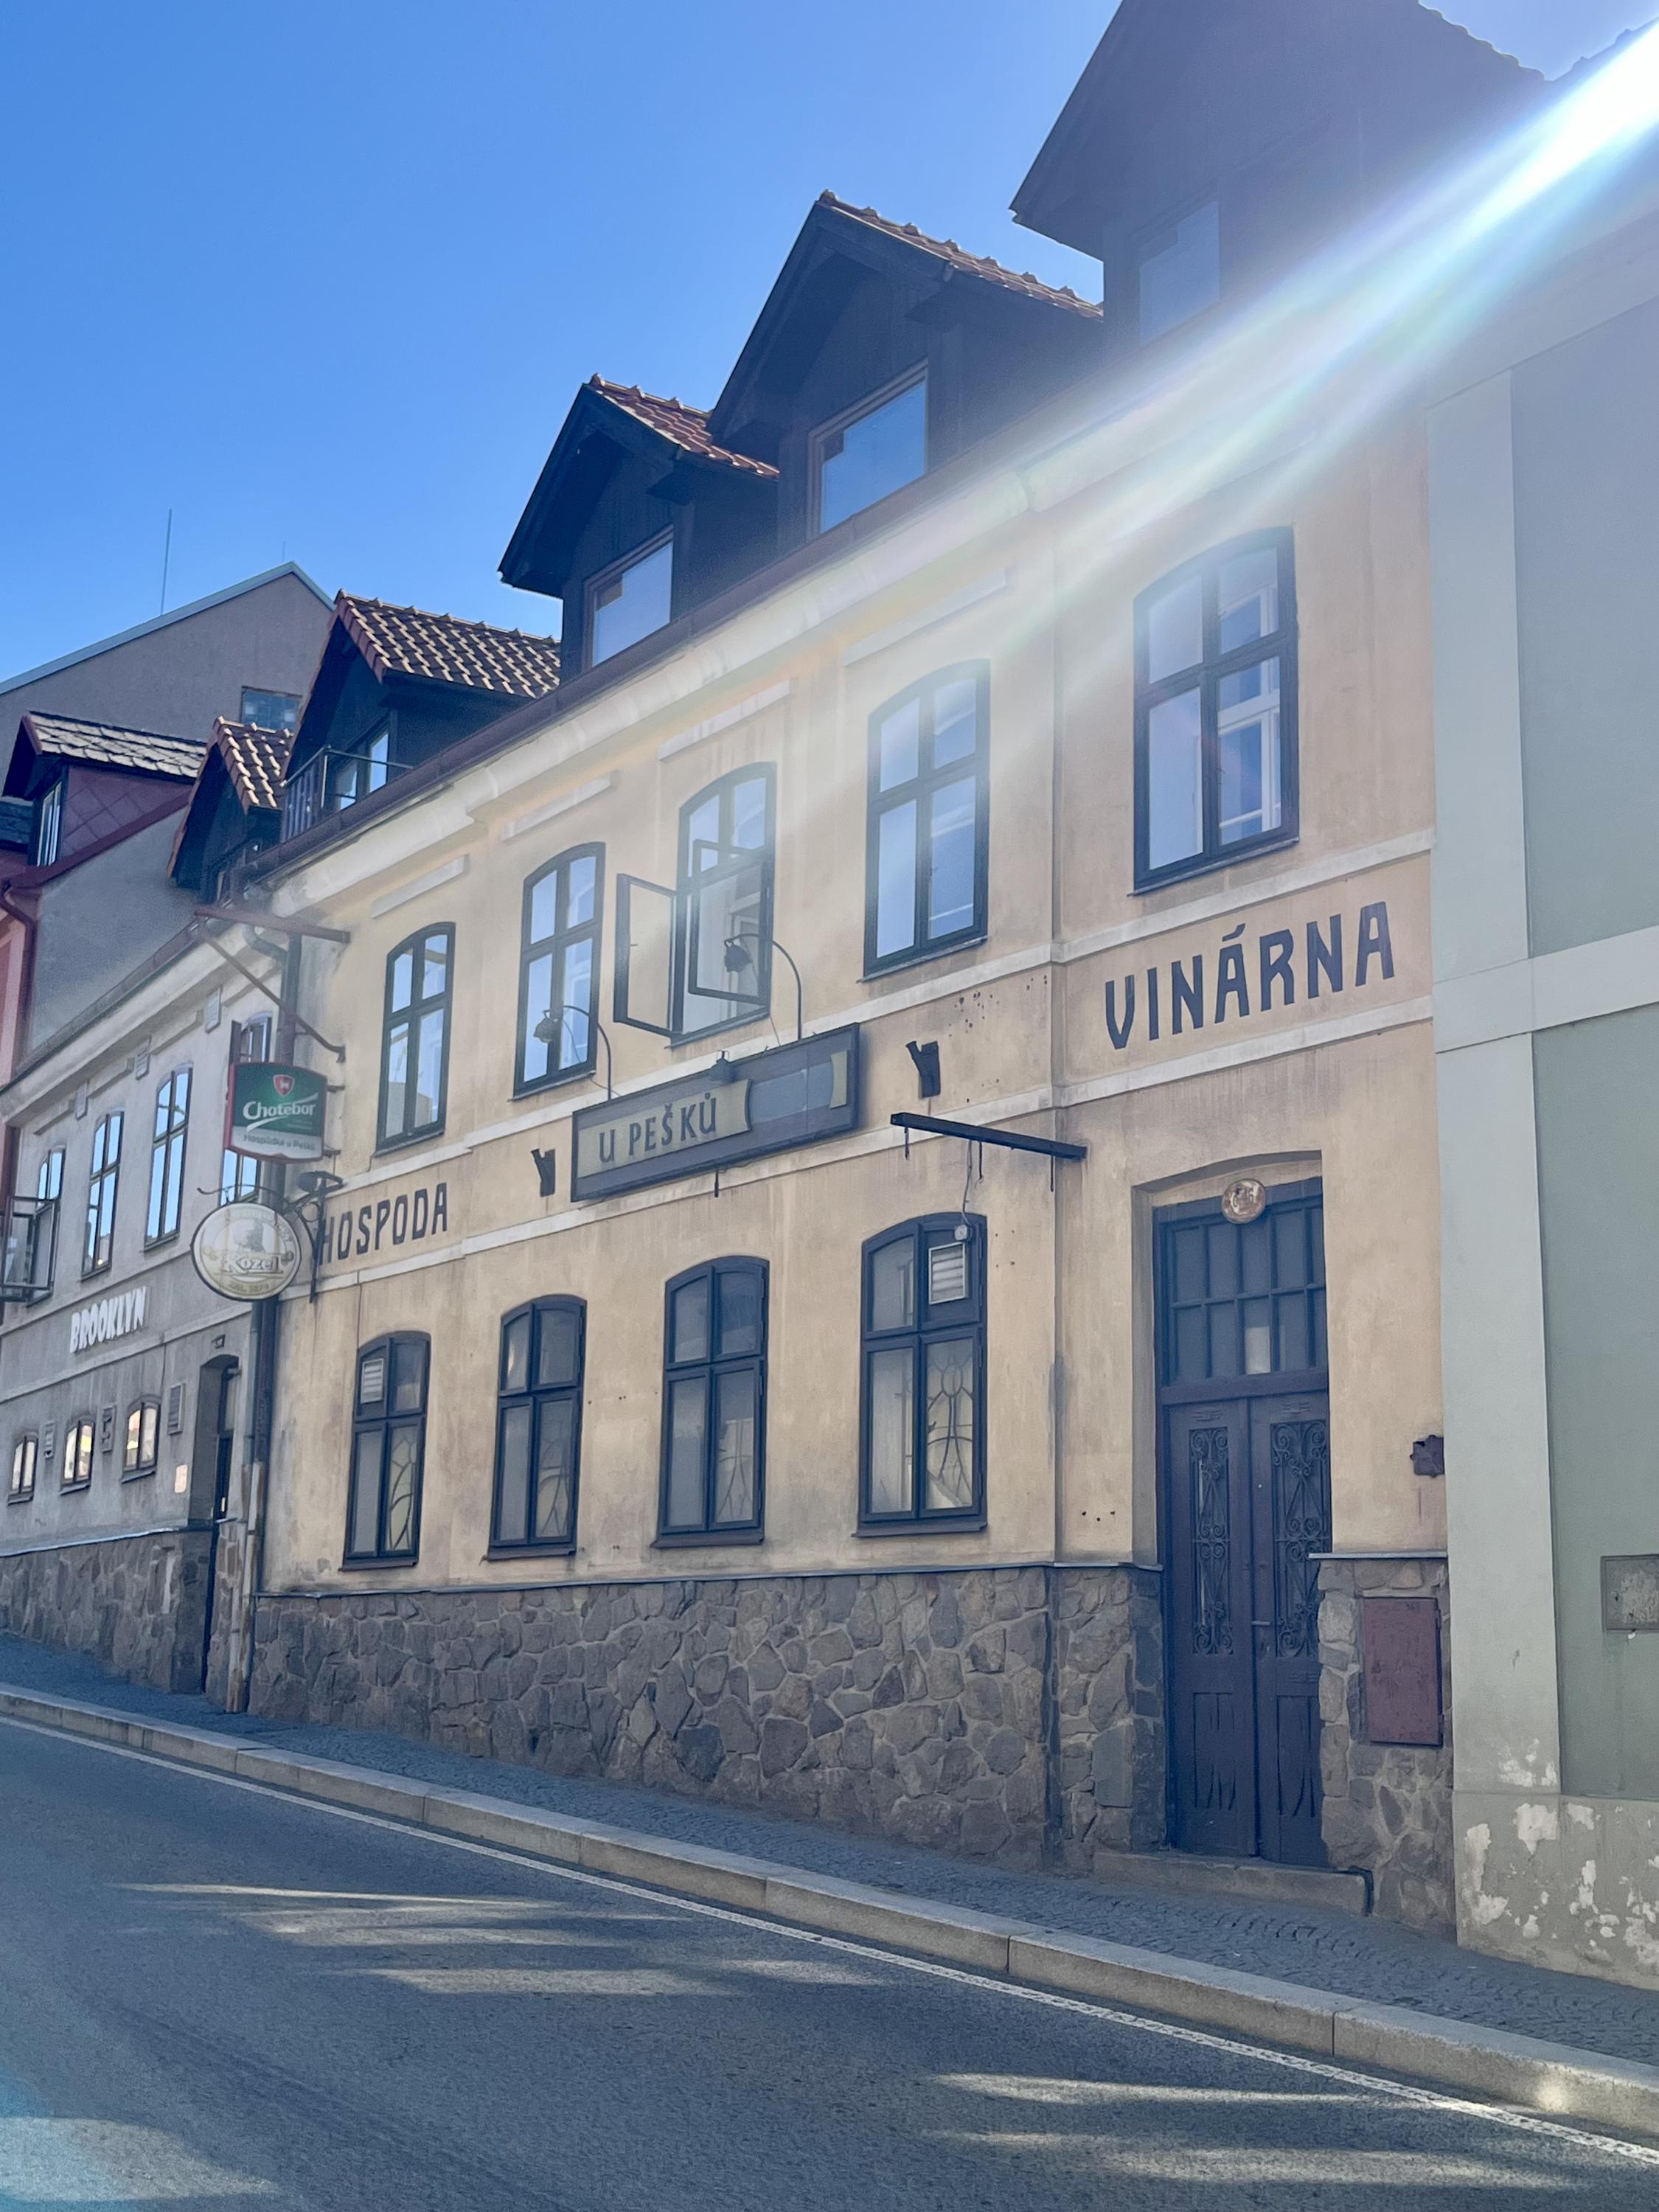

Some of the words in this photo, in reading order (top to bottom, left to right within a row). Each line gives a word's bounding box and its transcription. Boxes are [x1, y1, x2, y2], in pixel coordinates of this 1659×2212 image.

[1105, 901, 1395, 1050] VINÁRNA
[599, 1129, 616, 1164] U
[628, 1091, 717, 1156] PEŠKŮ
[318, 1182, 448, 1266] HOSPODA
[220, 1253, 284, 1274] Kozel
[69, 1285, 147, 1354] BROOKLYN
